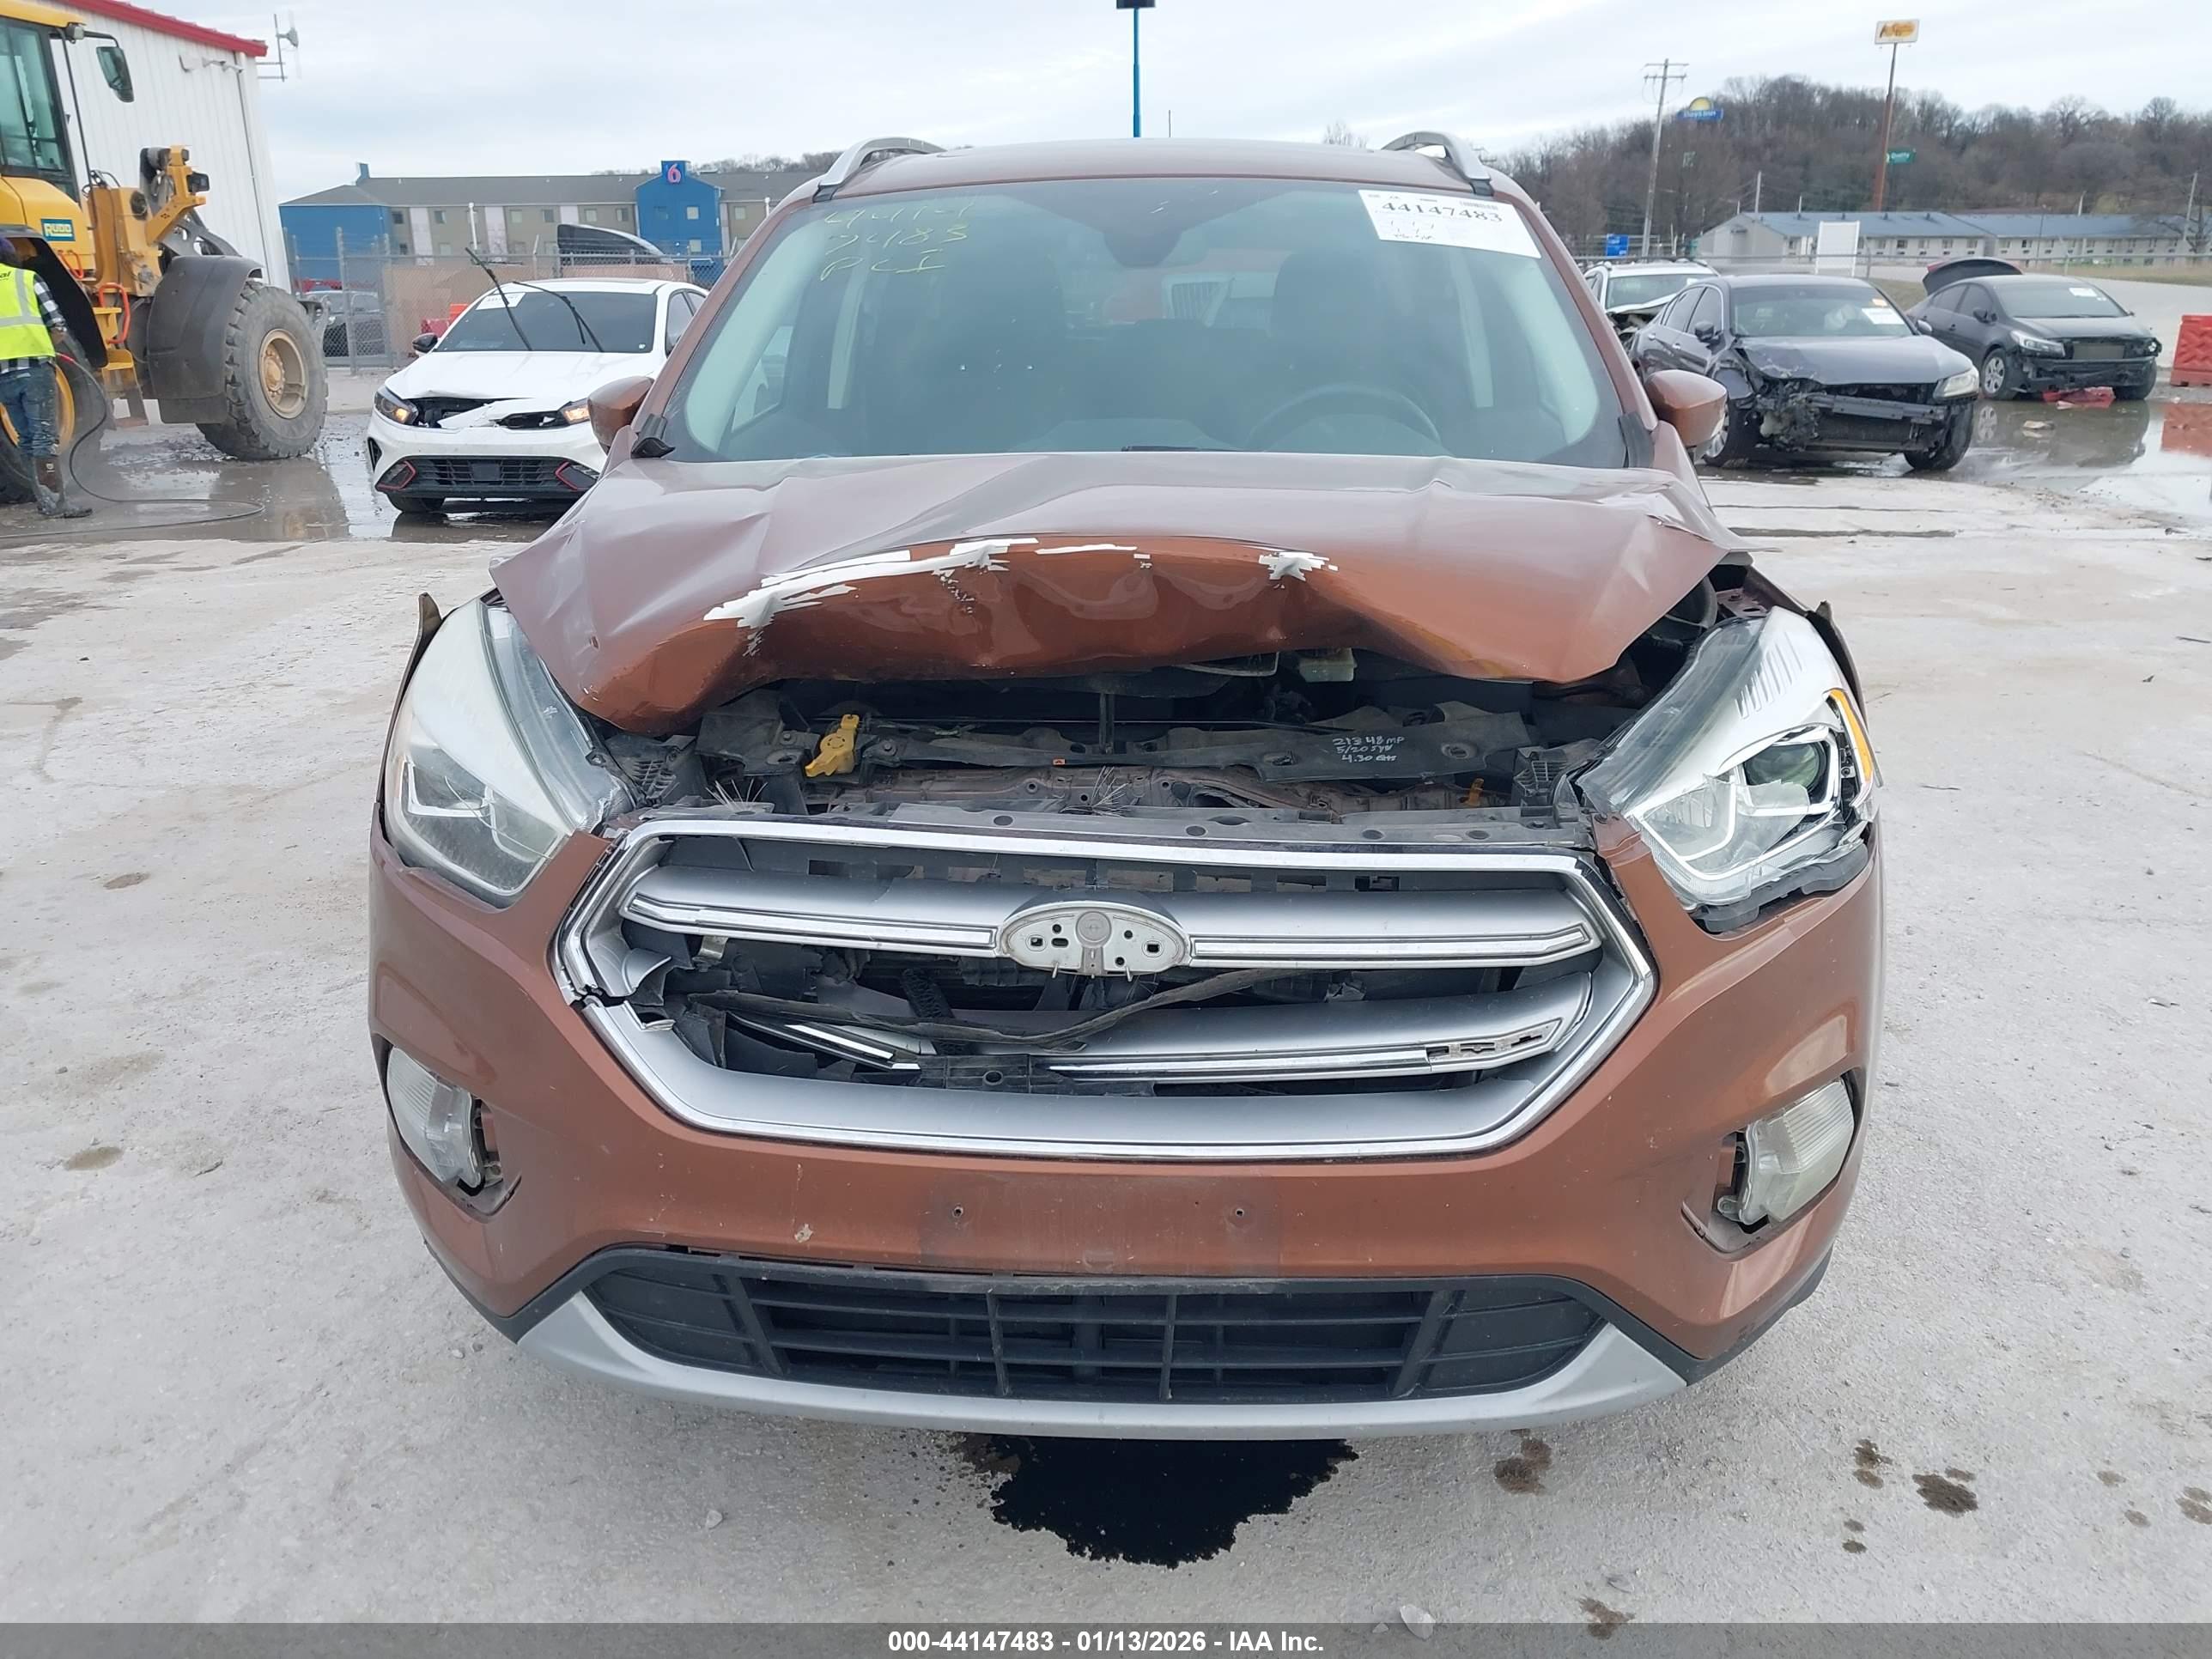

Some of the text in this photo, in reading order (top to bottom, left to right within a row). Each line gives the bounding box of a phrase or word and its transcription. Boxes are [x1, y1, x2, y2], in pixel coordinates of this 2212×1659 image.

[667, 163, 682, 183] 6
[1382, 202, 1503, 222] 44147483
[1336, 745, 1369, 754] 5/20
